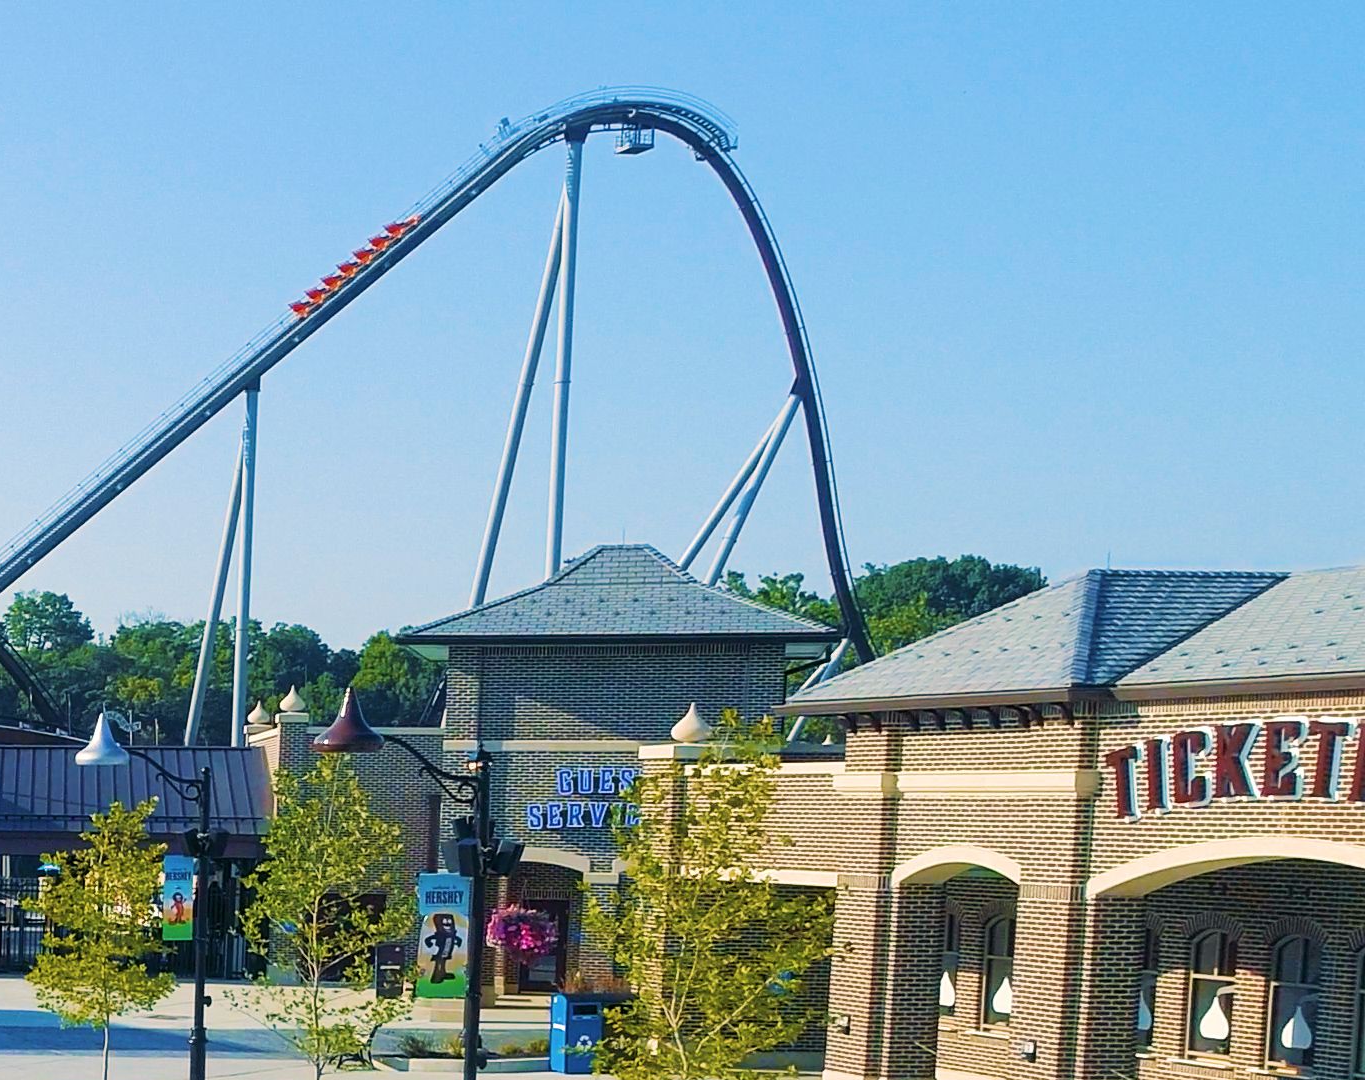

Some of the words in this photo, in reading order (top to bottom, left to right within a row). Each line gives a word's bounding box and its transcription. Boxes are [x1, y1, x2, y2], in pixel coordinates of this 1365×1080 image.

[557, 767, 642, 795] GUES
[1105, 716, 1365, 824] TICKET
[425, 891, 464, 905] HERSHEY
